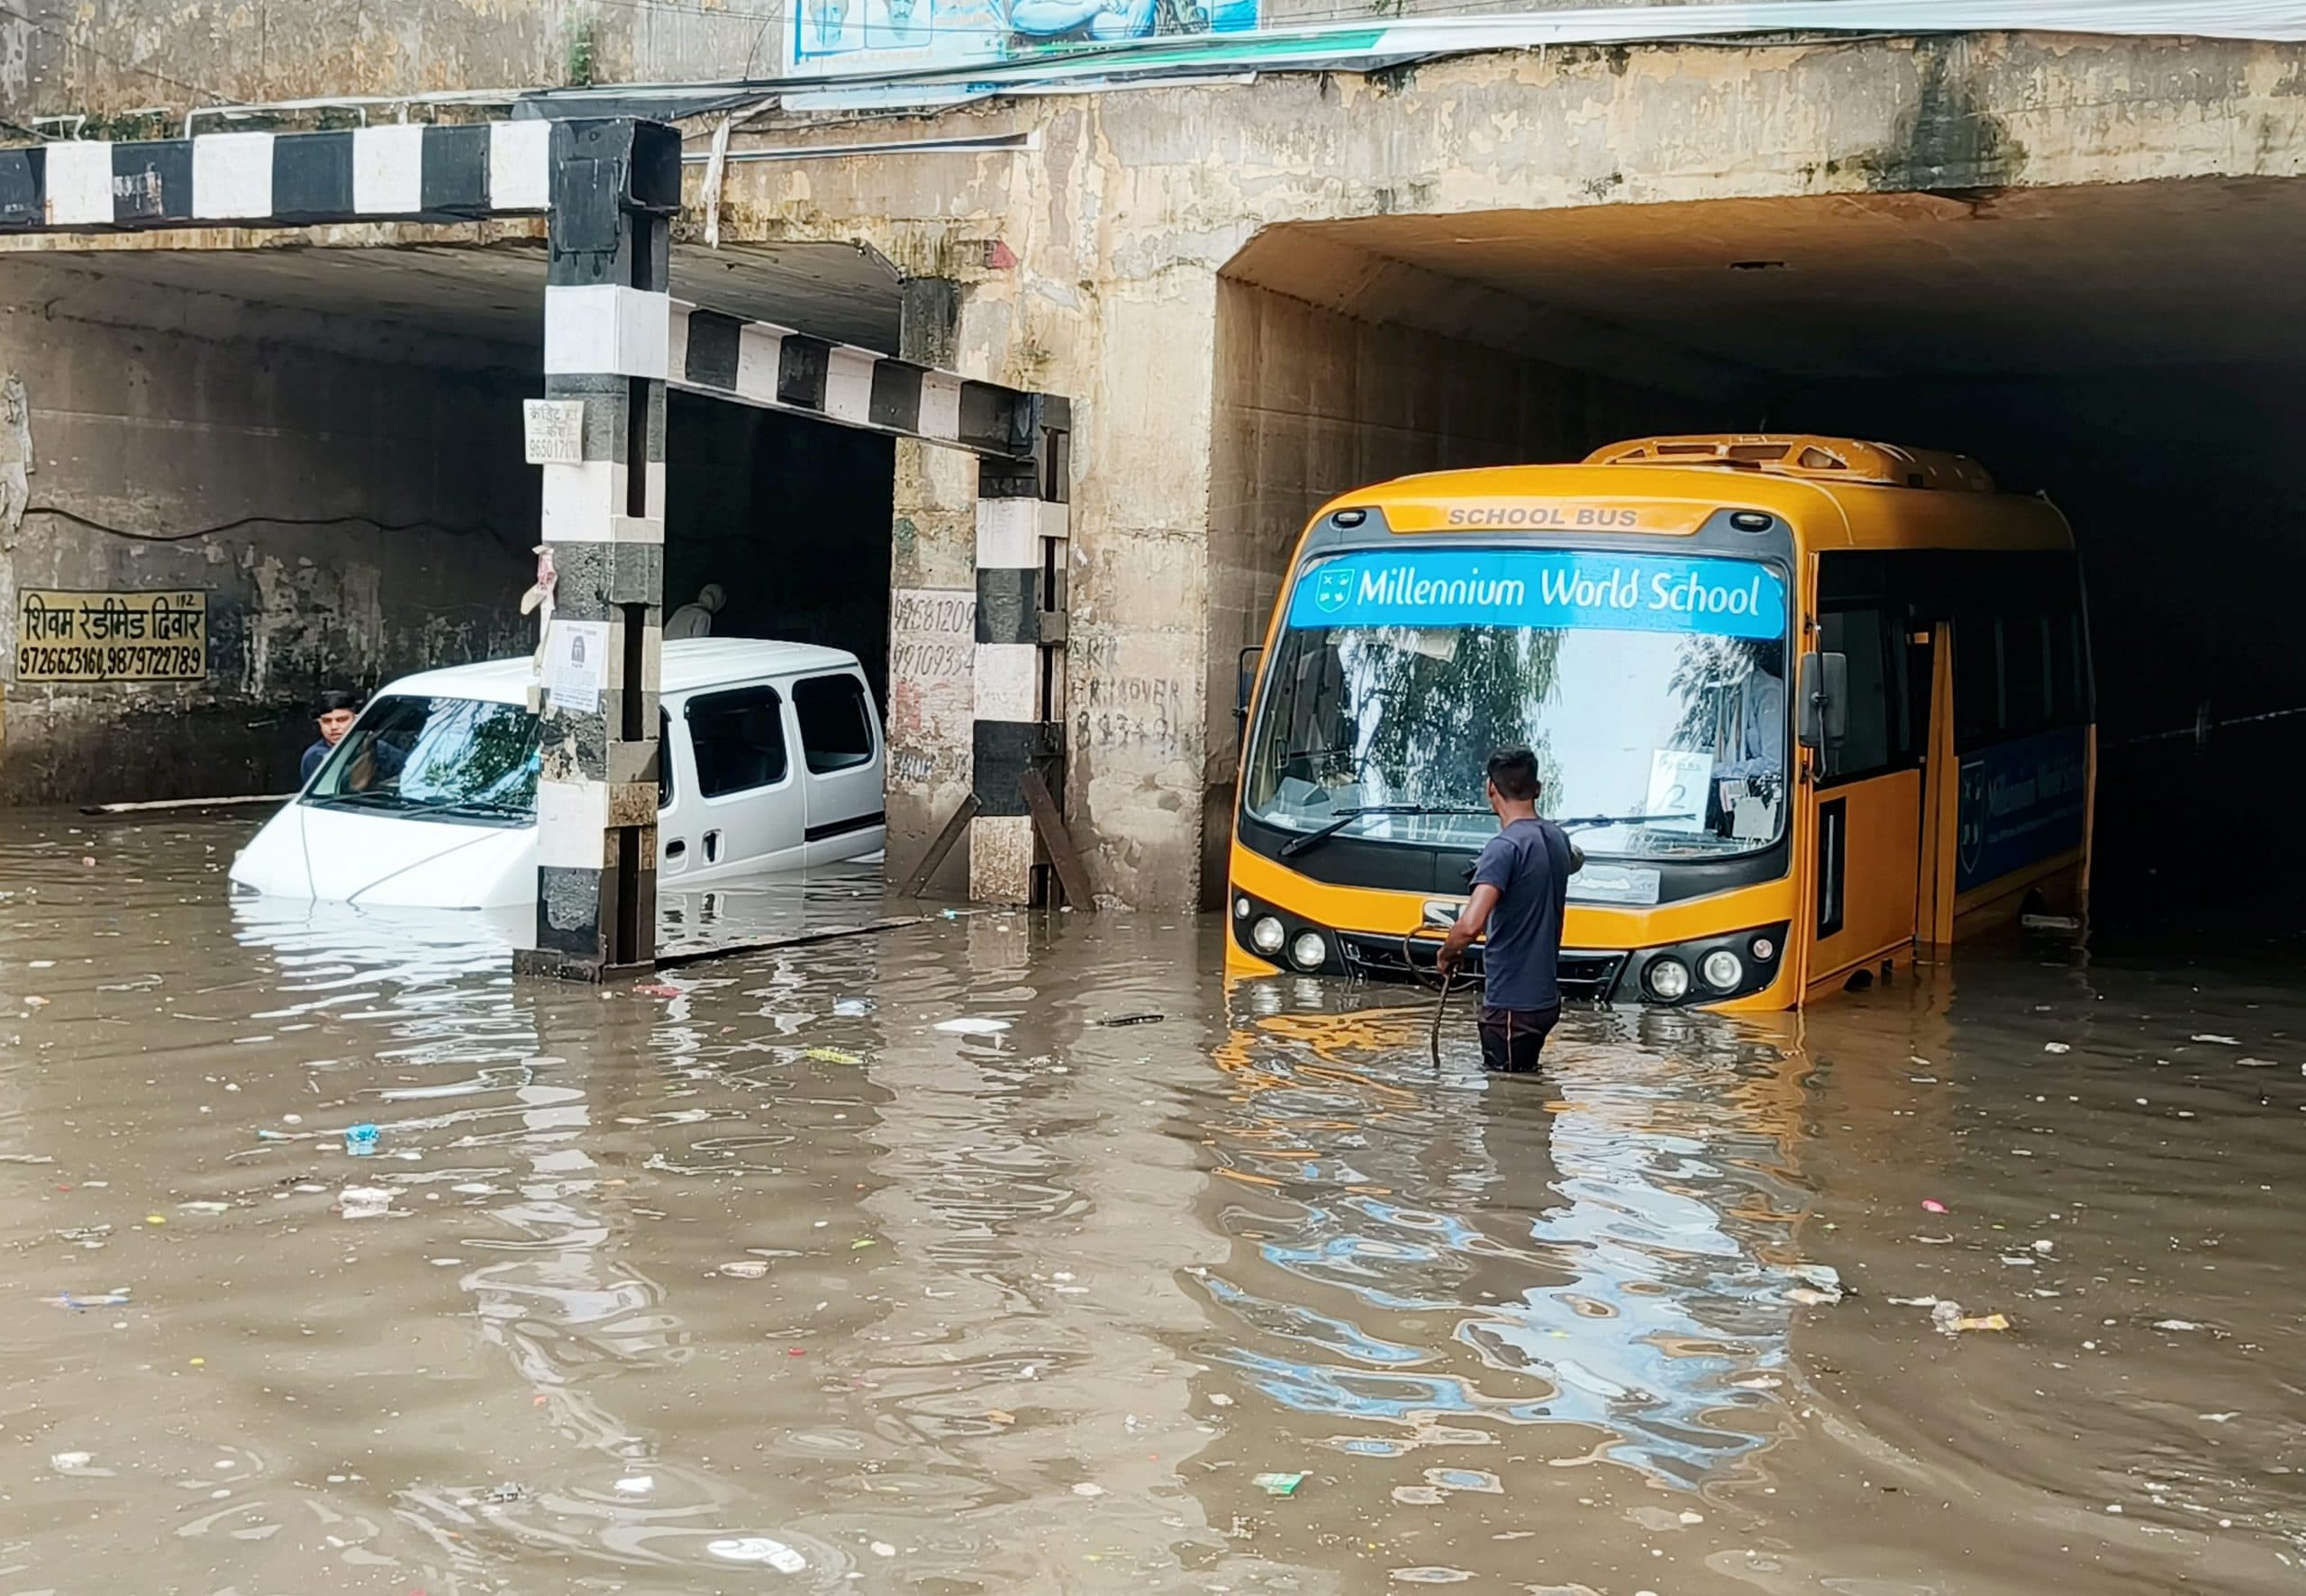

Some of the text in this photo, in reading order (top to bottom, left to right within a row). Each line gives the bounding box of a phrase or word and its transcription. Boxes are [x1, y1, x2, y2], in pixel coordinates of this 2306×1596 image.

[1448, 509, 1637, 526] SCHOOL BUS
[1356, 567, 1760, 616] Millennium World School
[23, 593, 75, 641] शिवम
